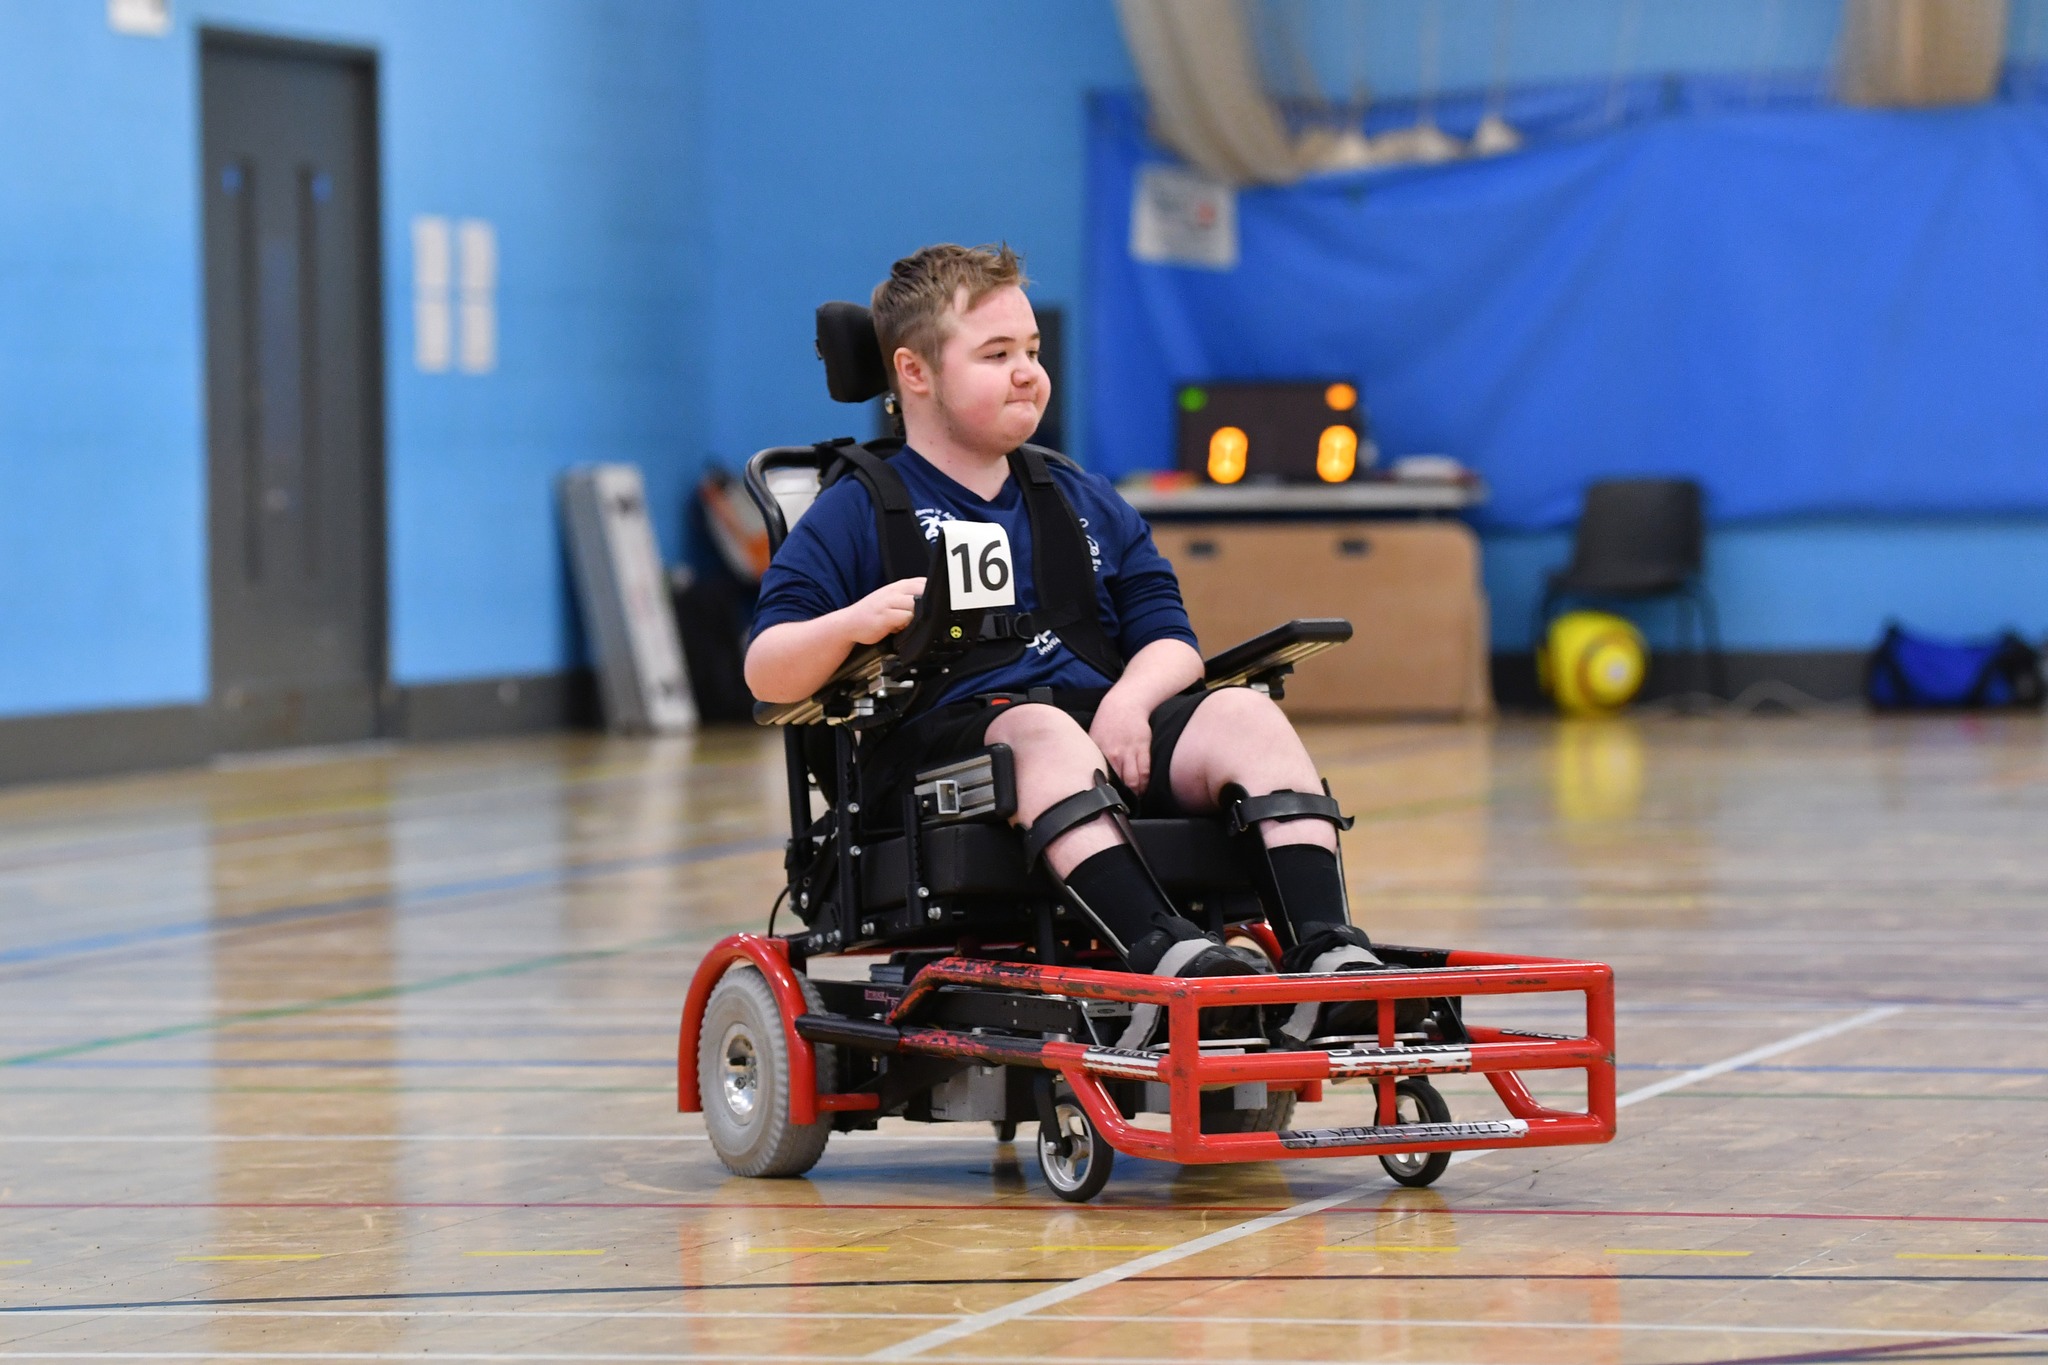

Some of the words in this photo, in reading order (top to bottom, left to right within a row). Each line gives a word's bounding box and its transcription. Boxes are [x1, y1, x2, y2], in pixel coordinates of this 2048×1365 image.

[951, 539, 1009, 594] 16
[1328, 1126, 1404, 1142] SPORTS
[1418, 1119, 1511, 1137] SERVICES
